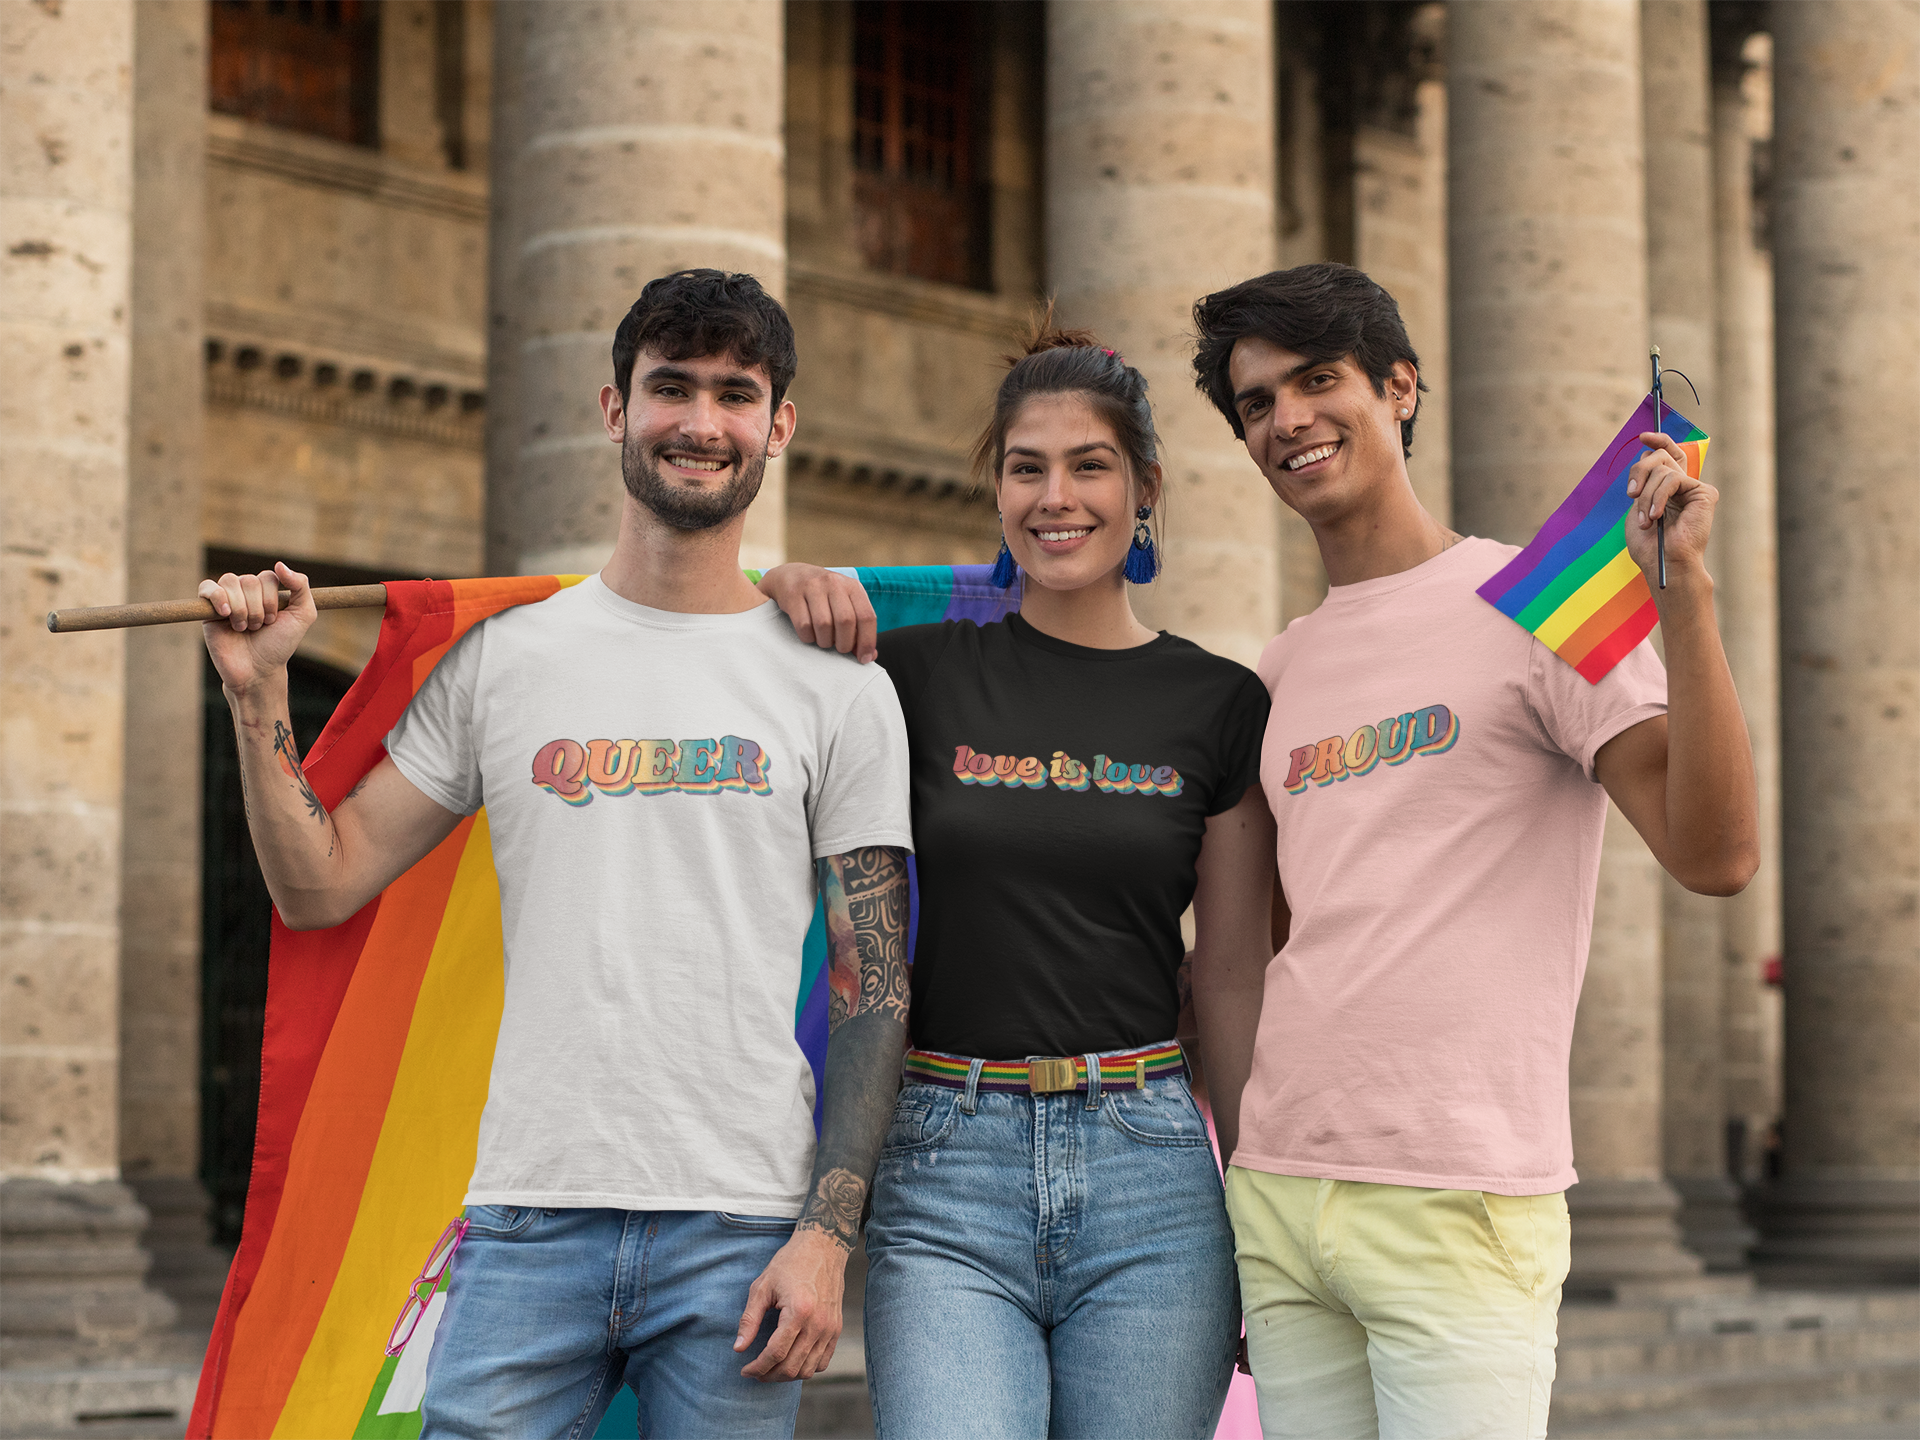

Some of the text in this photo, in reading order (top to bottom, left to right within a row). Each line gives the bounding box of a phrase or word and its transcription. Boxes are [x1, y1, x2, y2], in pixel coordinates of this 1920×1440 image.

[532, 735, 773, 808] QUEER
[953, 745, 1184, 797] love is love
[1283, 704, 1460, 795] PROUD
